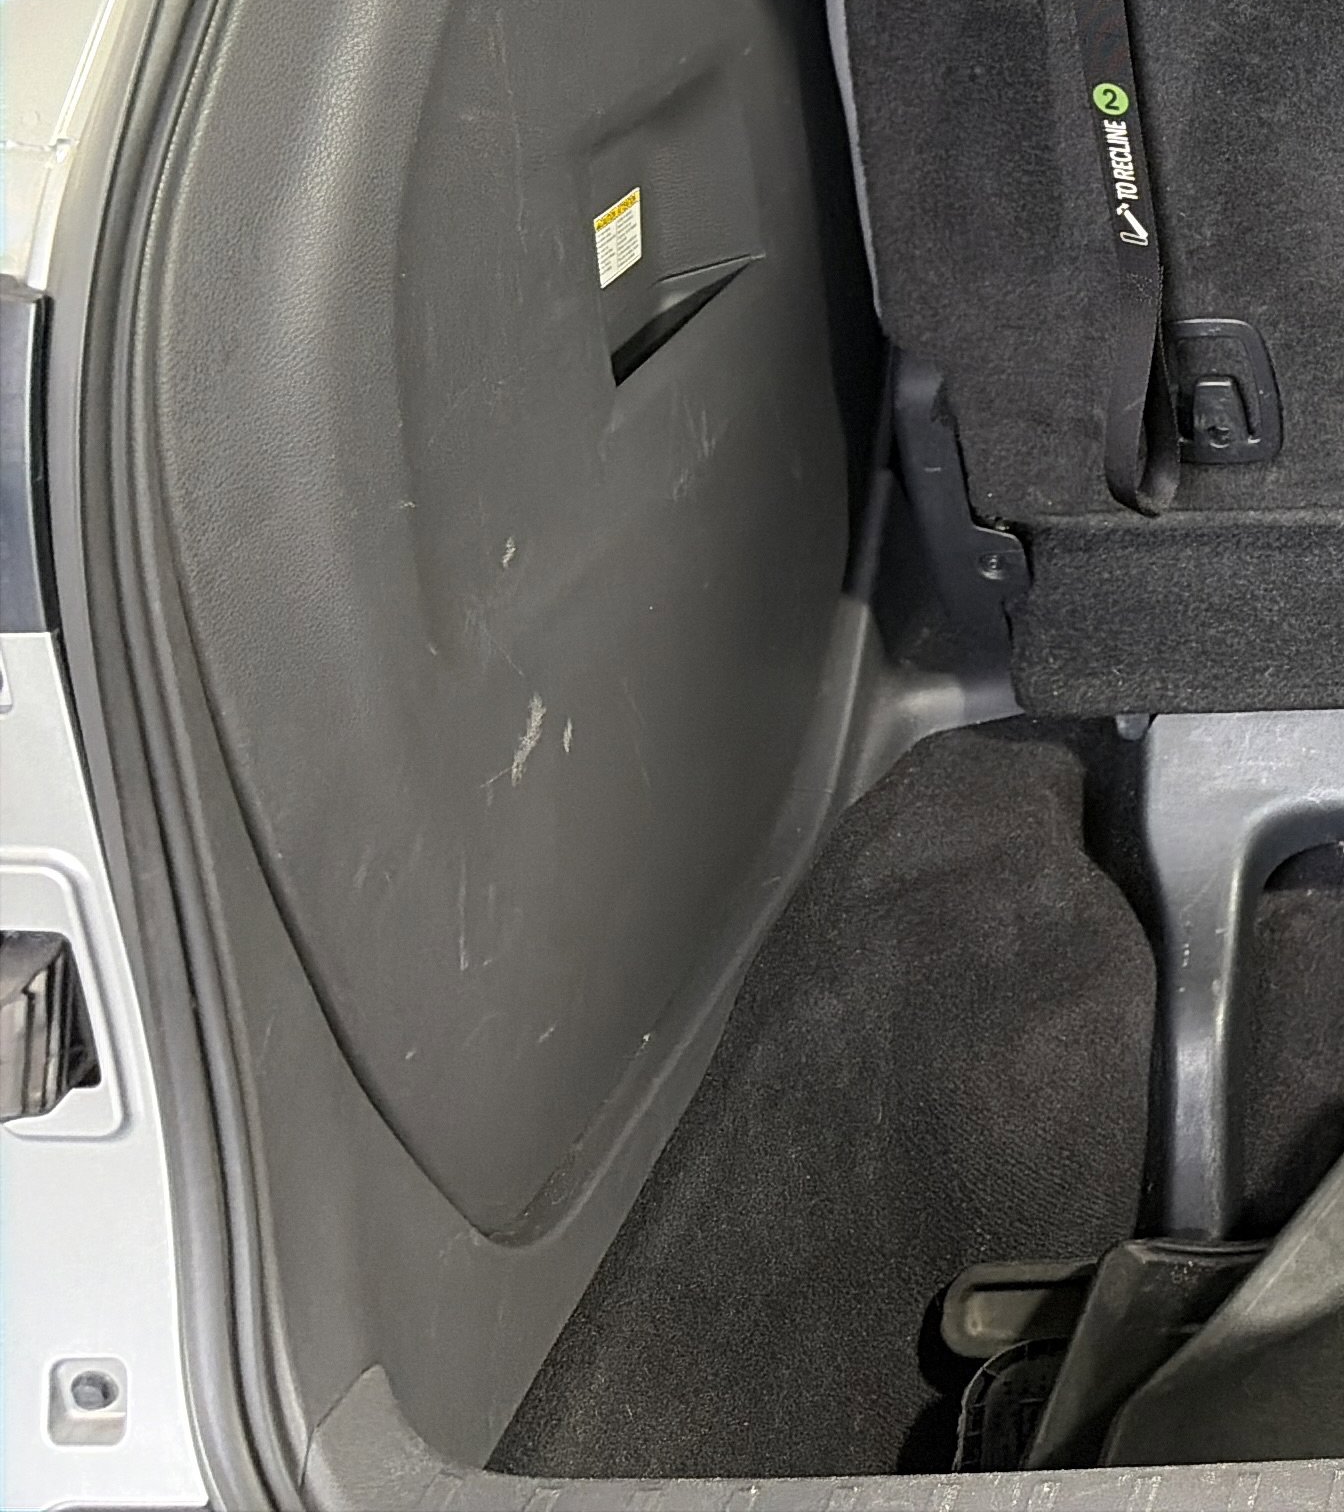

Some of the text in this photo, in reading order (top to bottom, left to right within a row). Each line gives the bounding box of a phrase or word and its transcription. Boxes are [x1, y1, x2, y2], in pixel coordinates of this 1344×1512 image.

[1102, 88, 1120, 111] 2
[1104, 119, 1139, 200] TO RECLINE
